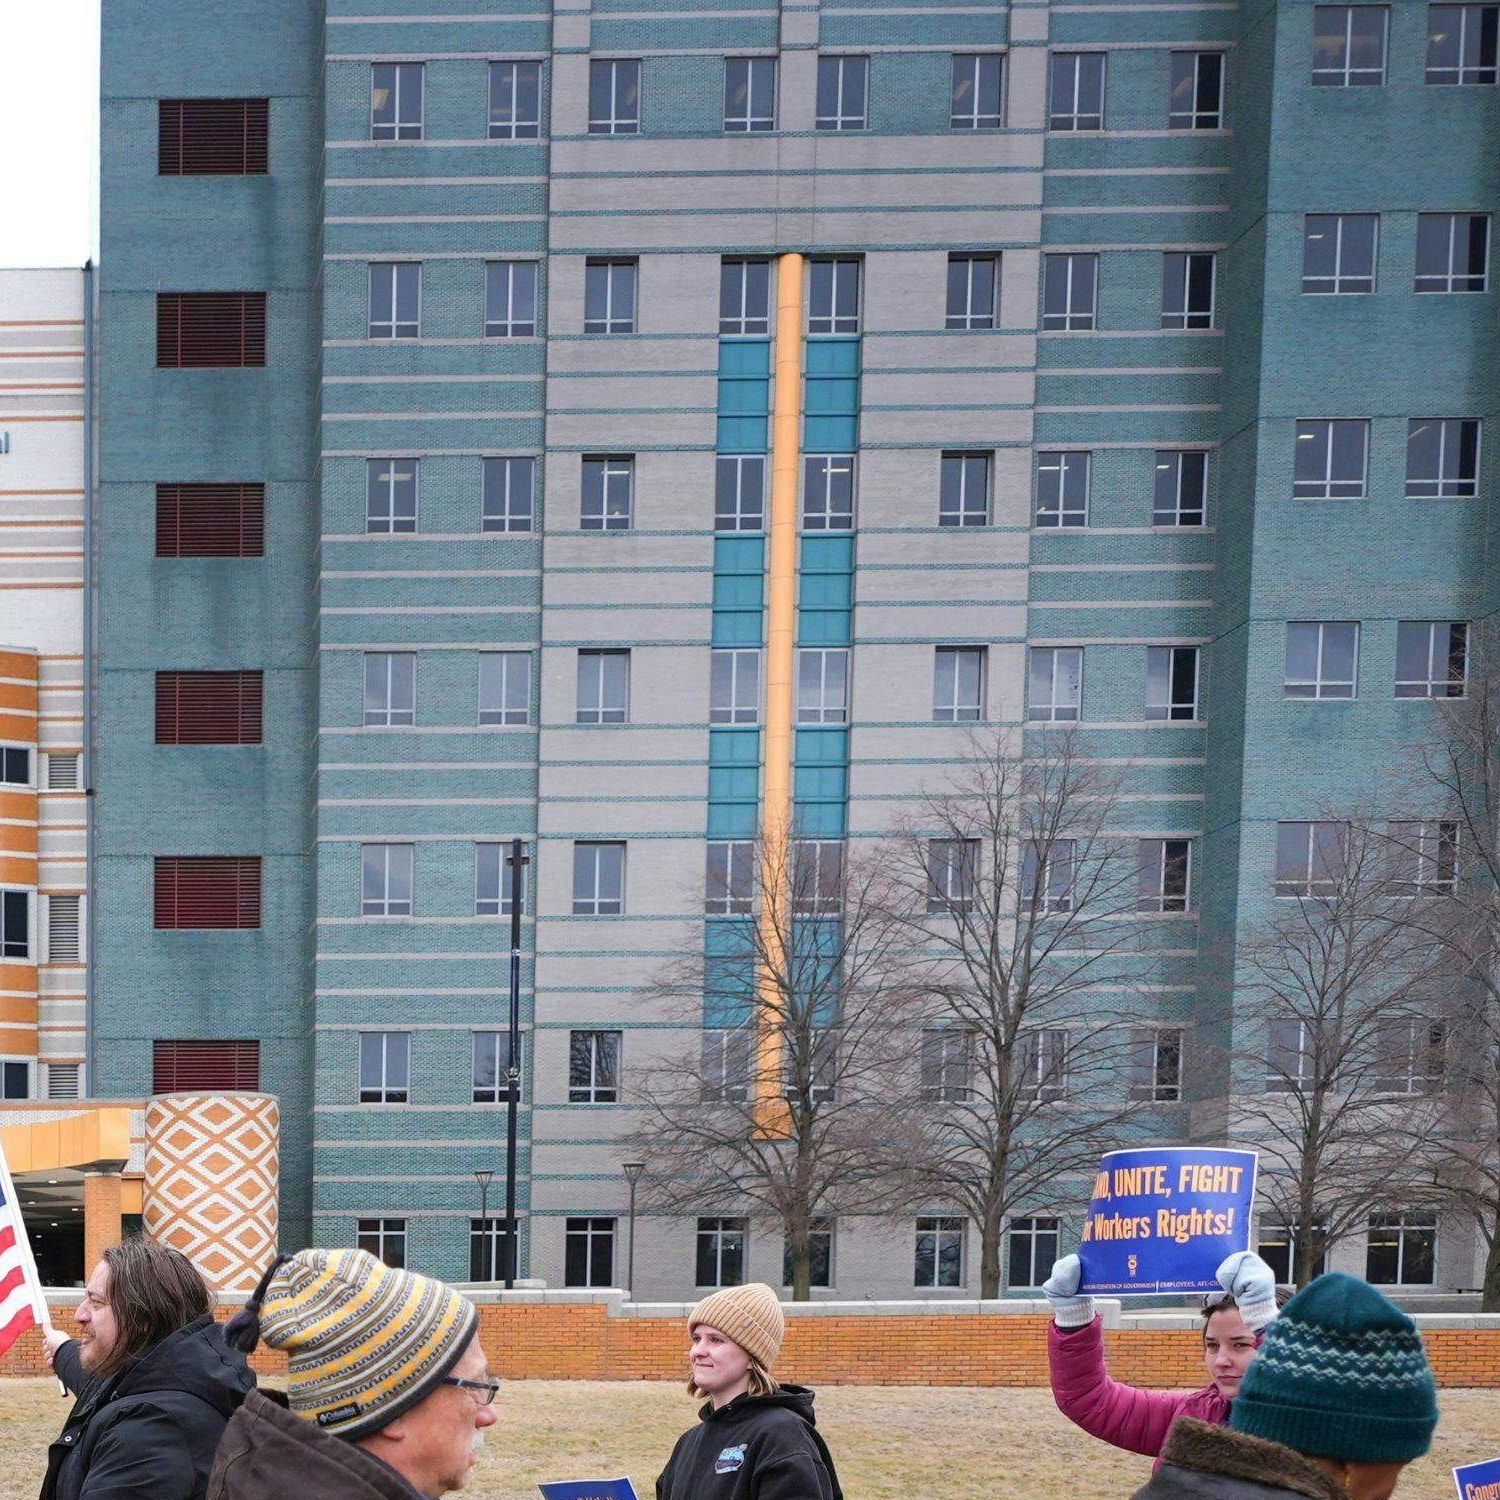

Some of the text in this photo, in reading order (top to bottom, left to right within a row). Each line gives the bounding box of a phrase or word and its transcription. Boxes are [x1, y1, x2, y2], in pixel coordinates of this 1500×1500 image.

[1114, 1165, 1171, 1198] UNITE,
[1178, 1165, 1243, 1194] FIGHT
[1094, 1212, 1150, 1241] Workers
[1156, 1207, 1235, 1243] Rights!
